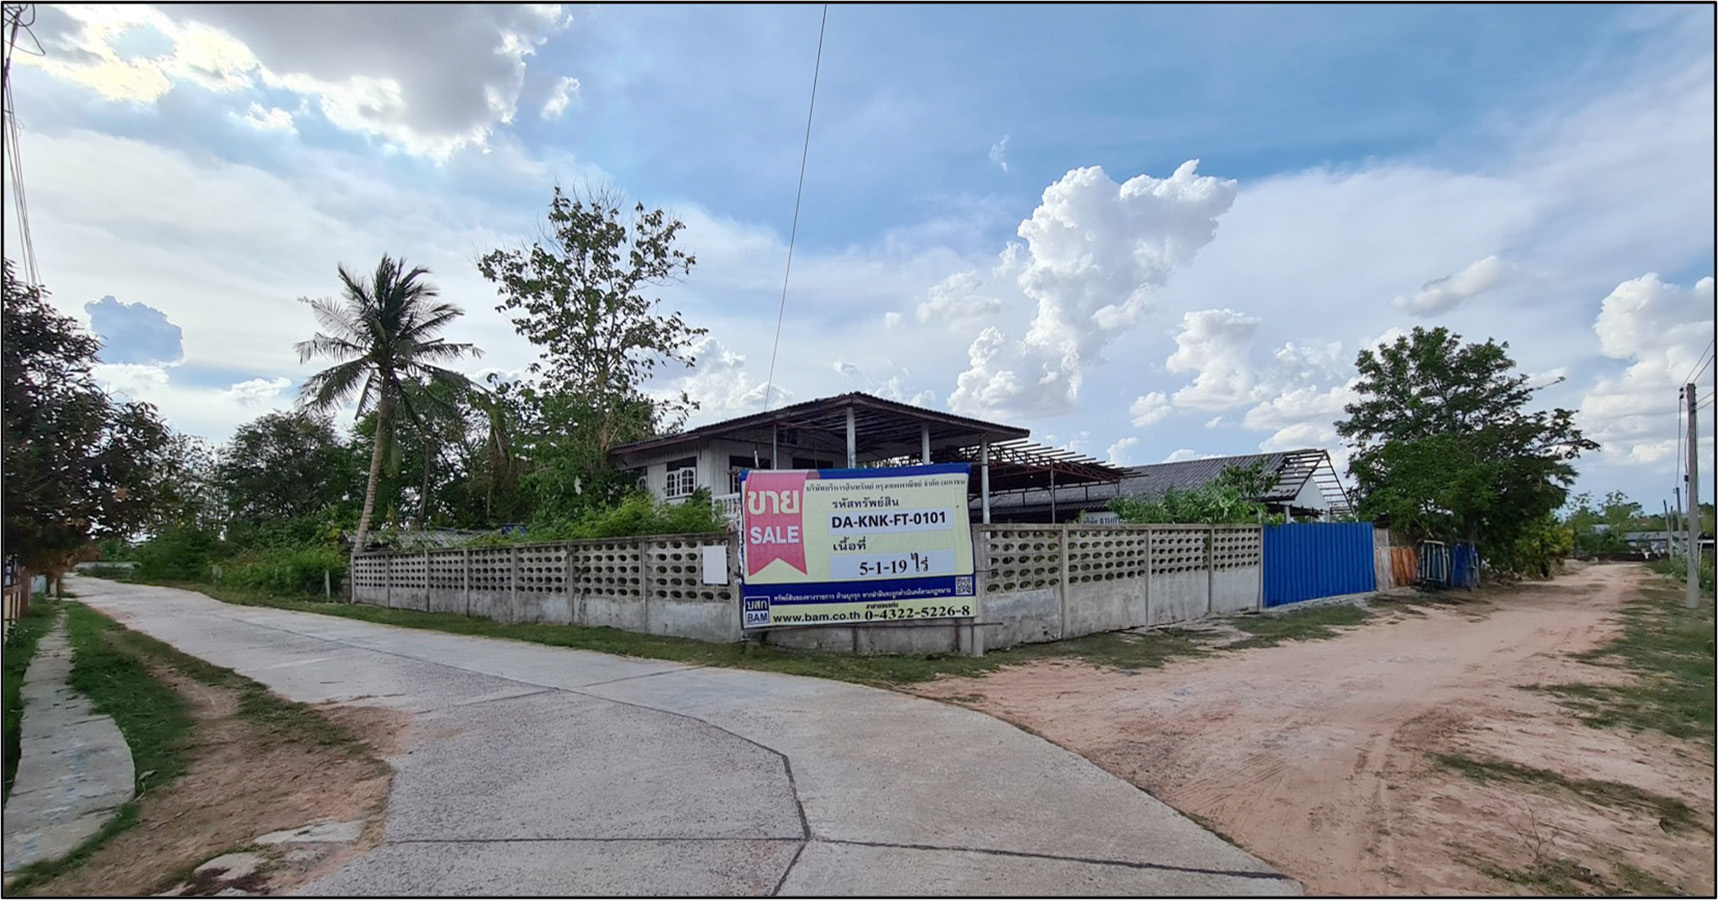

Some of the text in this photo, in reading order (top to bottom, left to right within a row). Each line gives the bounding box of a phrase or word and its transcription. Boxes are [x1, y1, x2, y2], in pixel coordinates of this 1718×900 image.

[748, 490, 800, 514] ขาย
[832, 497, 899, 508] รหัสทรัพย์สิน
[832, 511, 946, 529] DA-KNK-FT-0101
[750, 526, 800, 545] SALE
[833, 536, 867, 551] เนื้อที่
[859, 552, 929, 576] 5-1-19 ไร่
[747, 612, 768, 623] BAM
[773, 612, 861, 622] www.bam.co.th
[864, 605, 971, 620] 0-4322-5226-8
